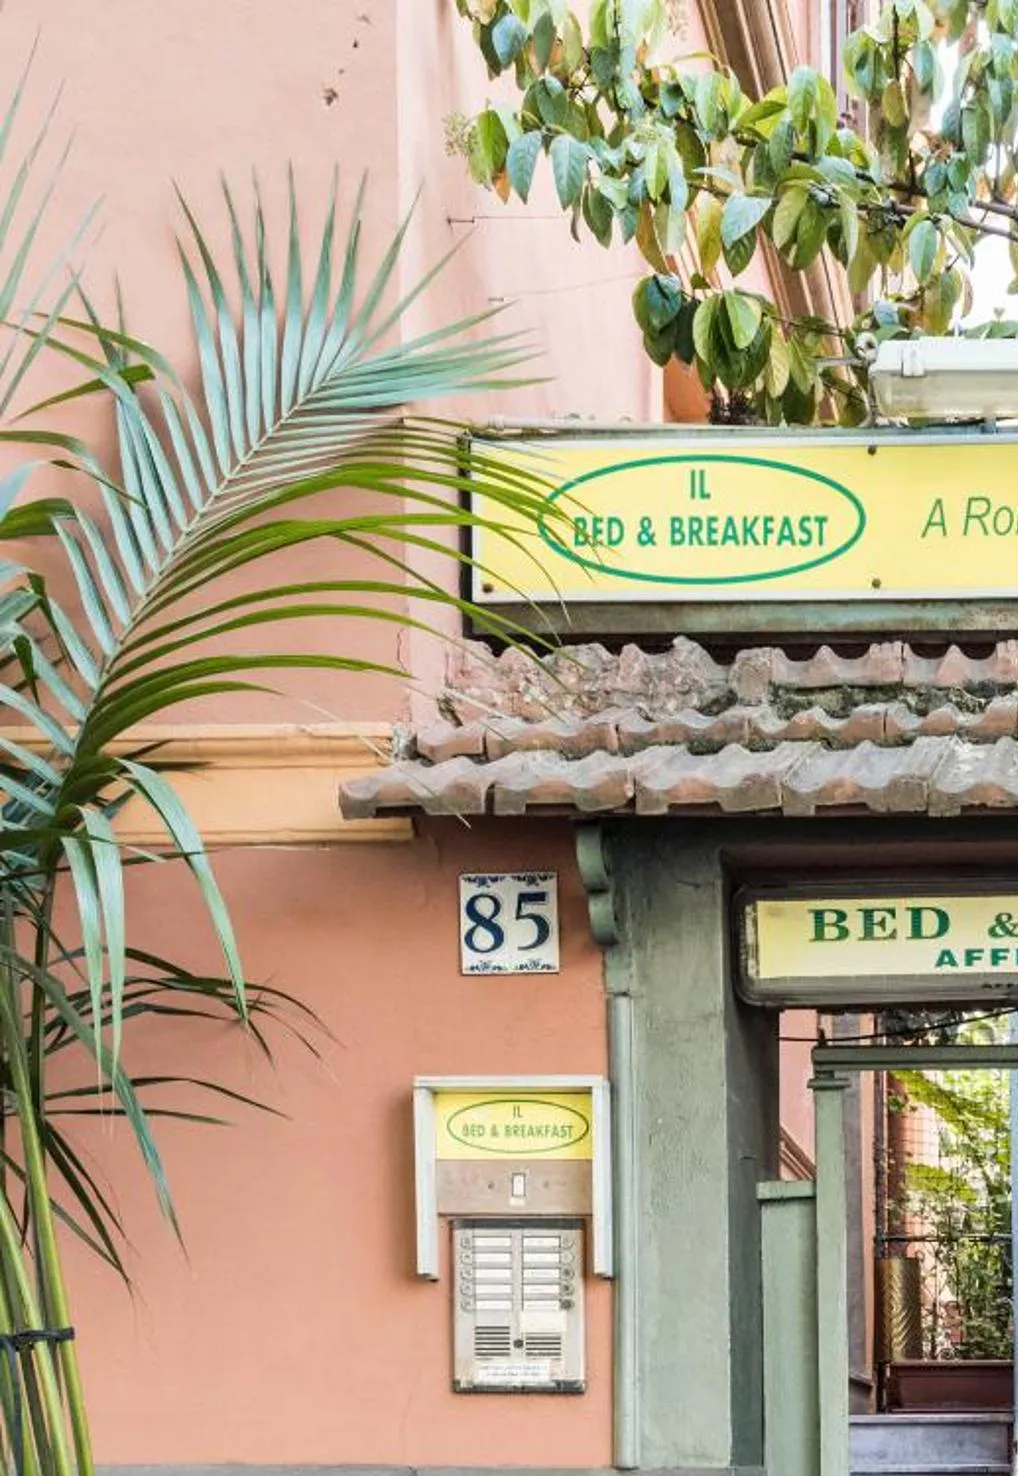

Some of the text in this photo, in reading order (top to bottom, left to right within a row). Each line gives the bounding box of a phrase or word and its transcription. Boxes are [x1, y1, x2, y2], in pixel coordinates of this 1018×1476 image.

[690, 469, 711, 500] IL
[574, 514, 828, 547] BED & BREAKFAST
[921, 498, 948, 538] A
[464, 890, 551, 955] 85
[807, 904, 952, 943] BED
[512, 1104, 523, 1119] IL
[461, 1123, 574, 1139] BED & BREAKFAST
